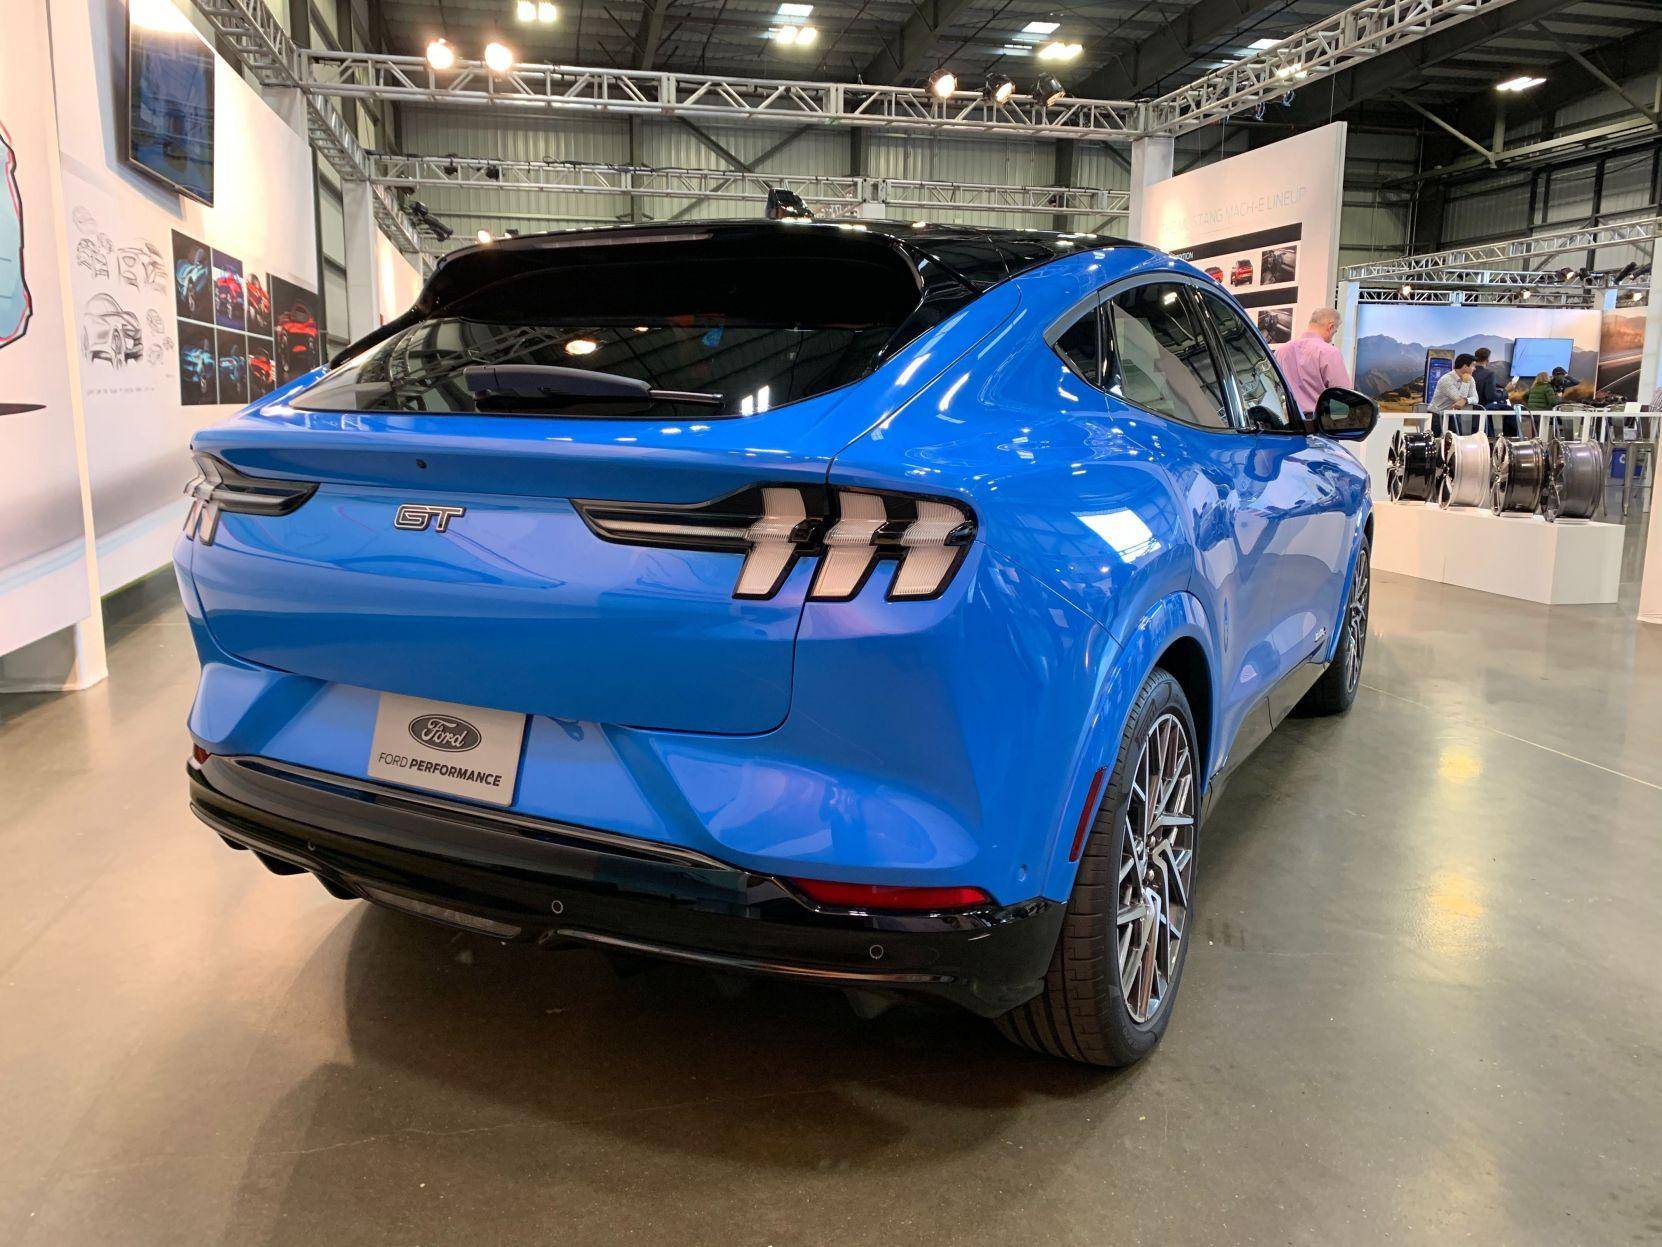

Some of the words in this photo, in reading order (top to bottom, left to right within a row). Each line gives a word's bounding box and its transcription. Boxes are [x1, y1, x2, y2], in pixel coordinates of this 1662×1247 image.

[1266, 186, 1307, 210] LINEUP
[394, 504, 466, 533] GT
[421, 718, 468, 748] Ford
[378, 752, 408, 768] FORD
[409, 758, 503, 787] PERFORMANCE
